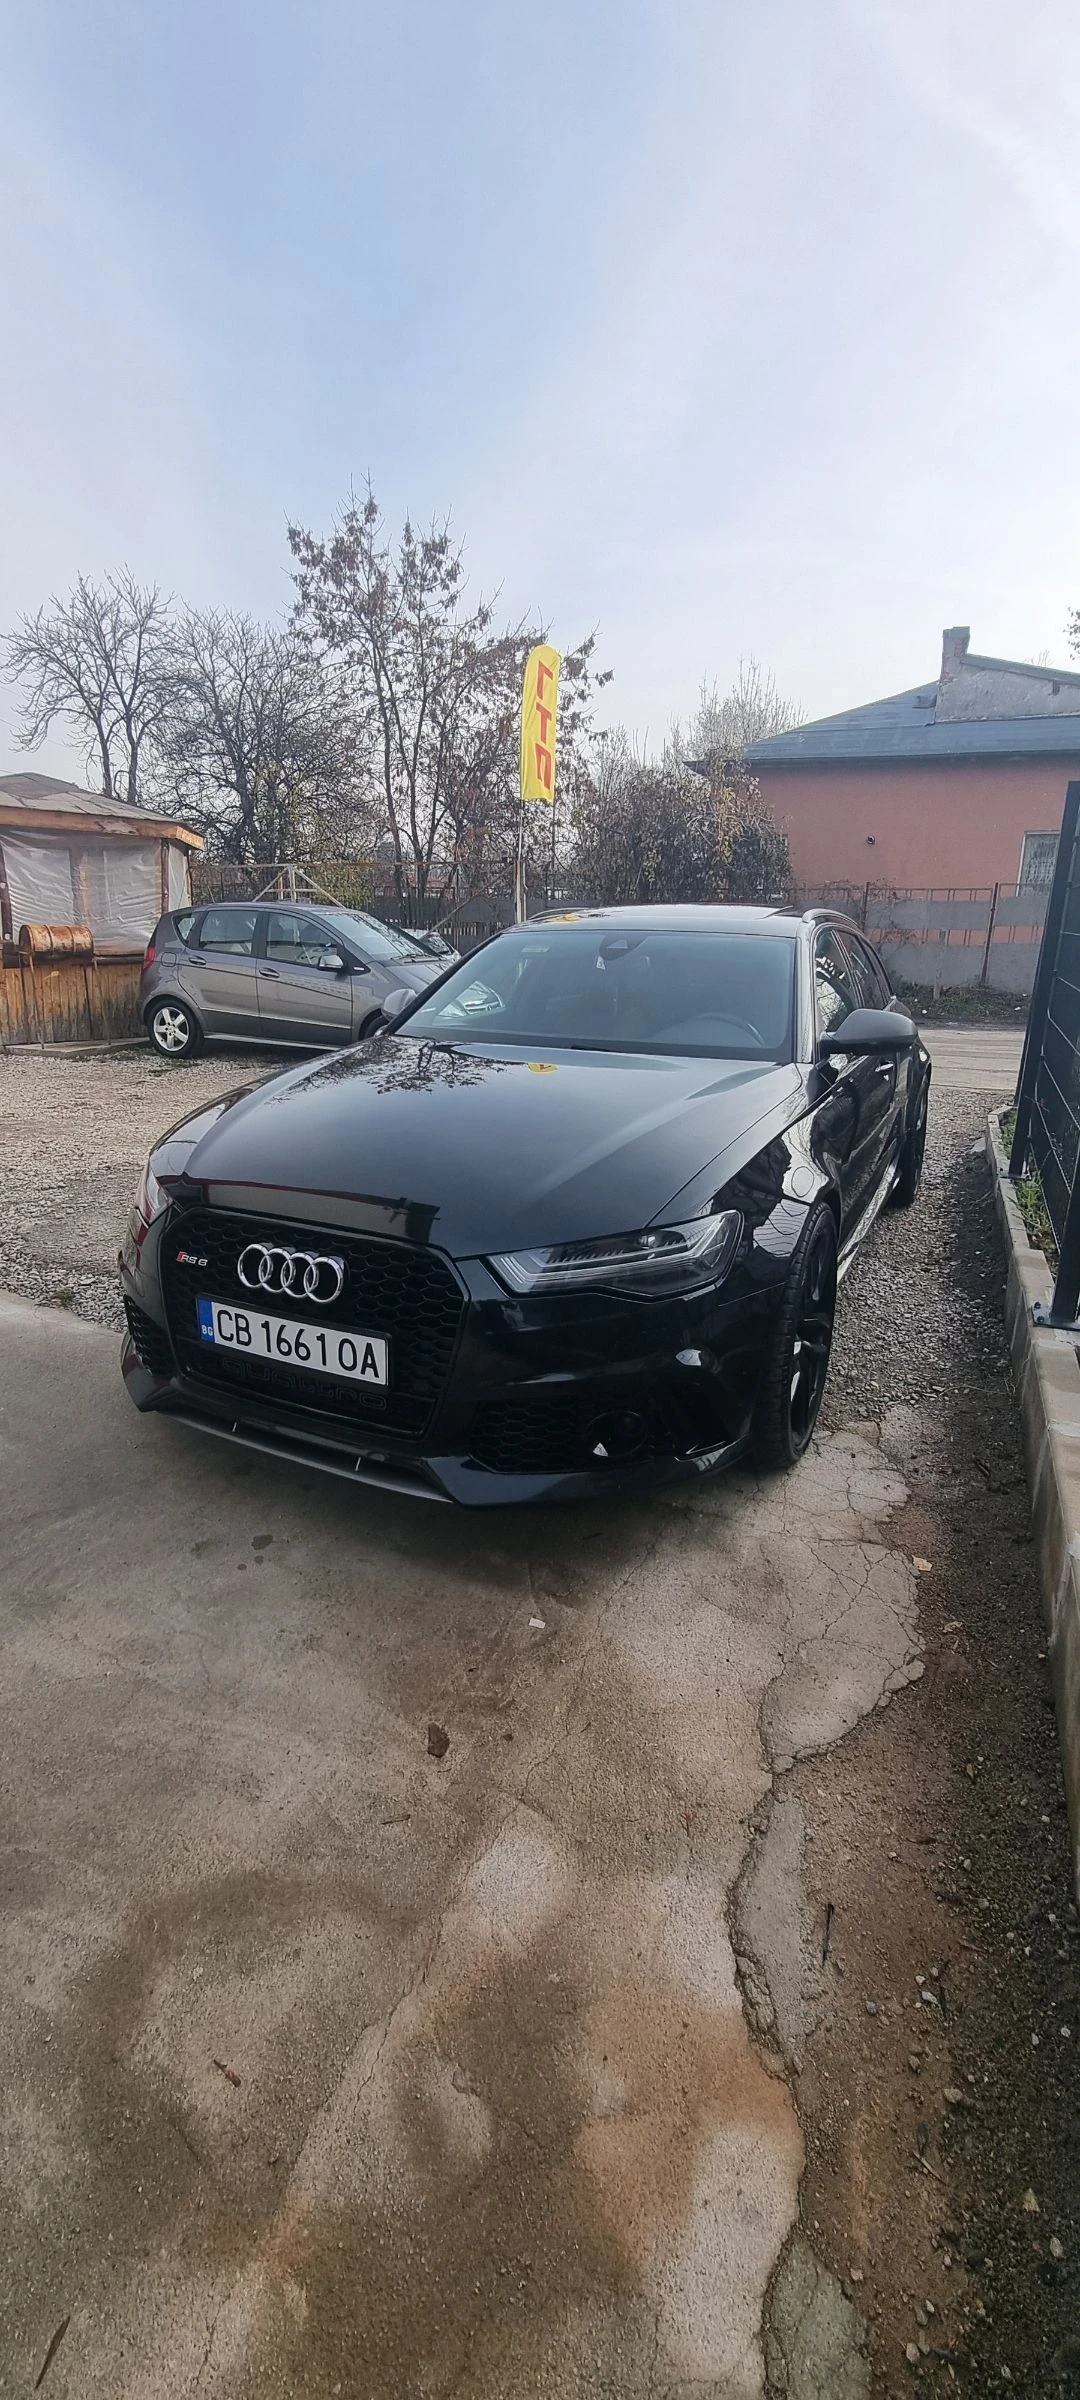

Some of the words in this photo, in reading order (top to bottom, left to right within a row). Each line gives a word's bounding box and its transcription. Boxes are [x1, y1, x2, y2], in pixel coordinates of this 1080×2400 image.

[201, 1323, 214, 1336] BG
[216, 1309, 252, 1347] CB
[260, 1320, 328, 1366] 1661
[338, 1338, 380, 1378] OA
